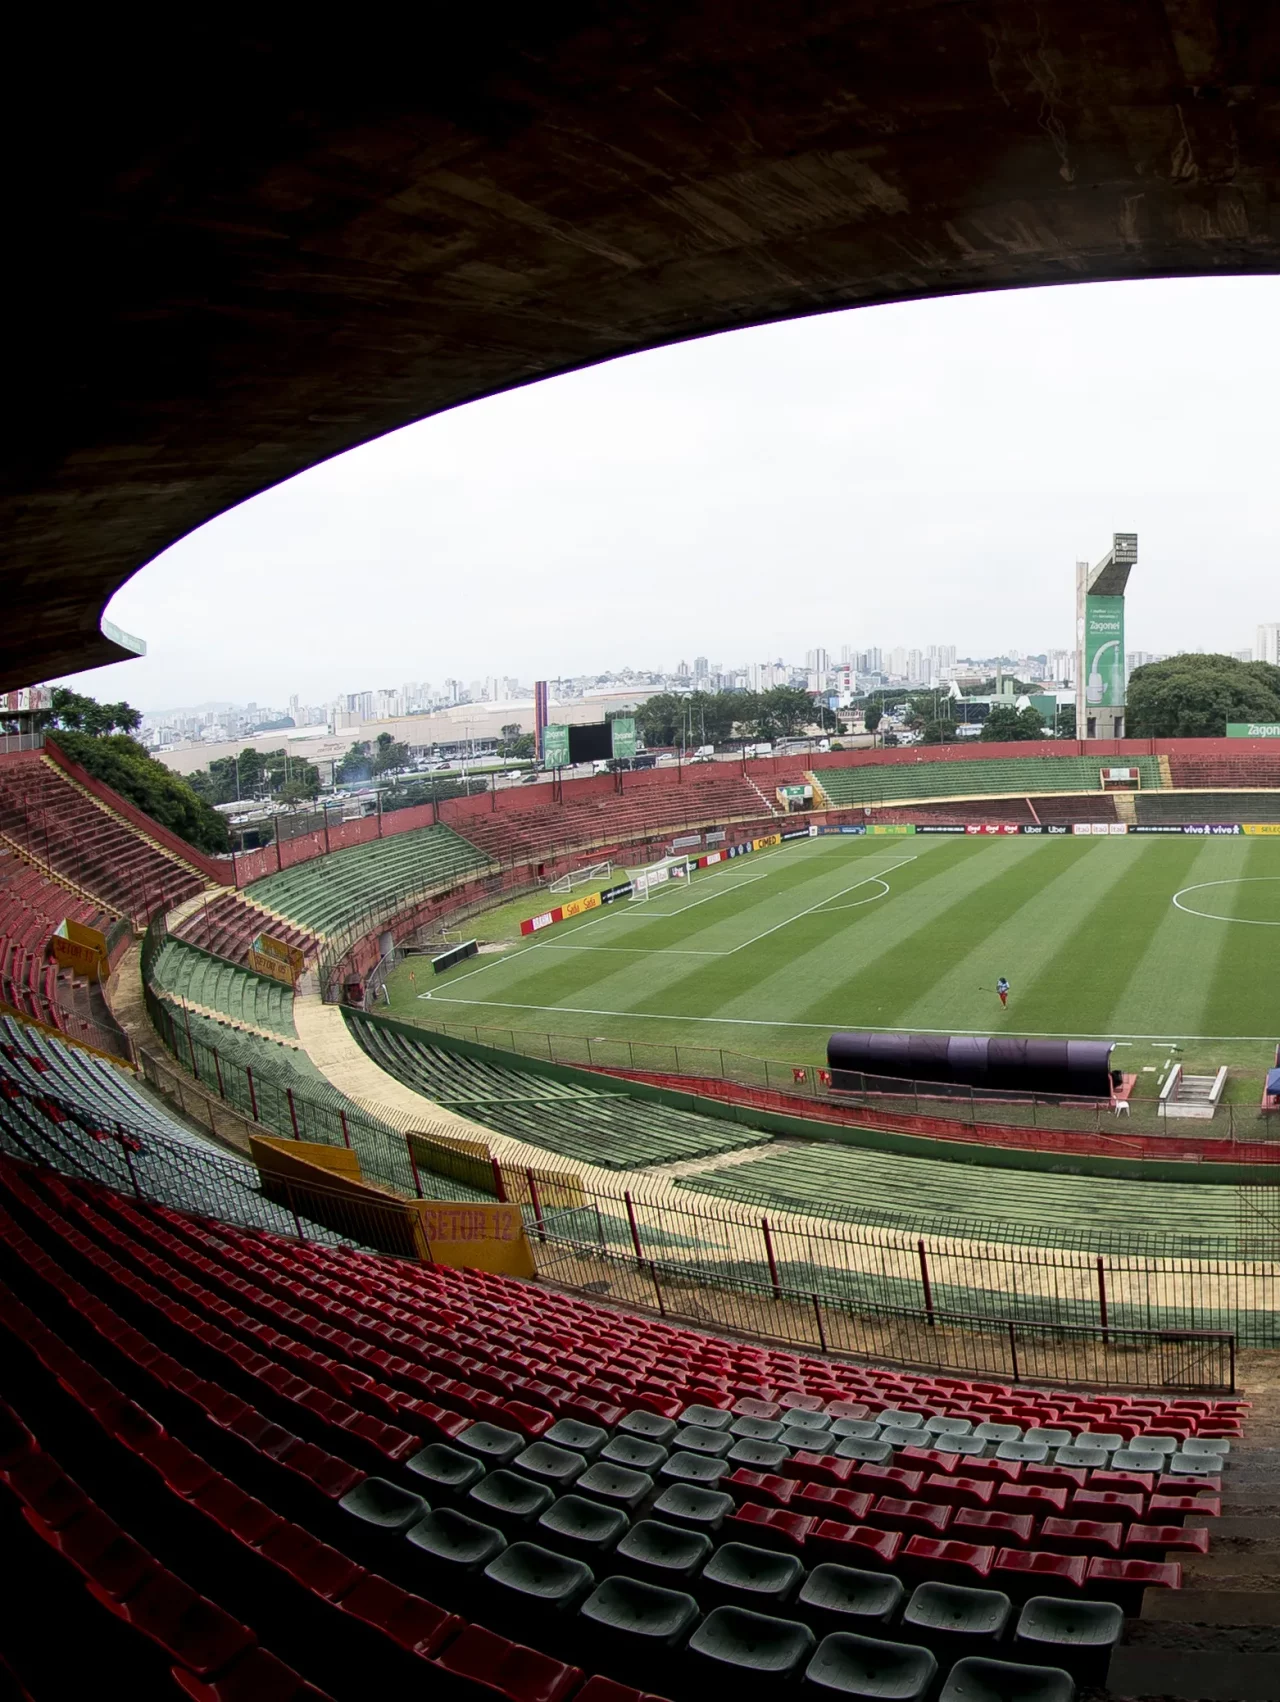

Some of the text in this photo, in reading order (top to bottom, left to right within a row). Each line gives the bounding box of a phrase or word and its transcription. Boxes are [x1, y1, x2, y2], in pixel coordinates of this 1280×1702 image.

[1090, 620, 1120, 631] Zagonel
[1184, 825, 1203, 834] vivo
[1213, 825, 1232, 834] vivo
[758, 836, 776, 847] CIMED
[57, 939, 82, 957] SETOR
[255, 955, 277, 970] SETOR
[424, 1209, 512, 1241] SETOR 12
